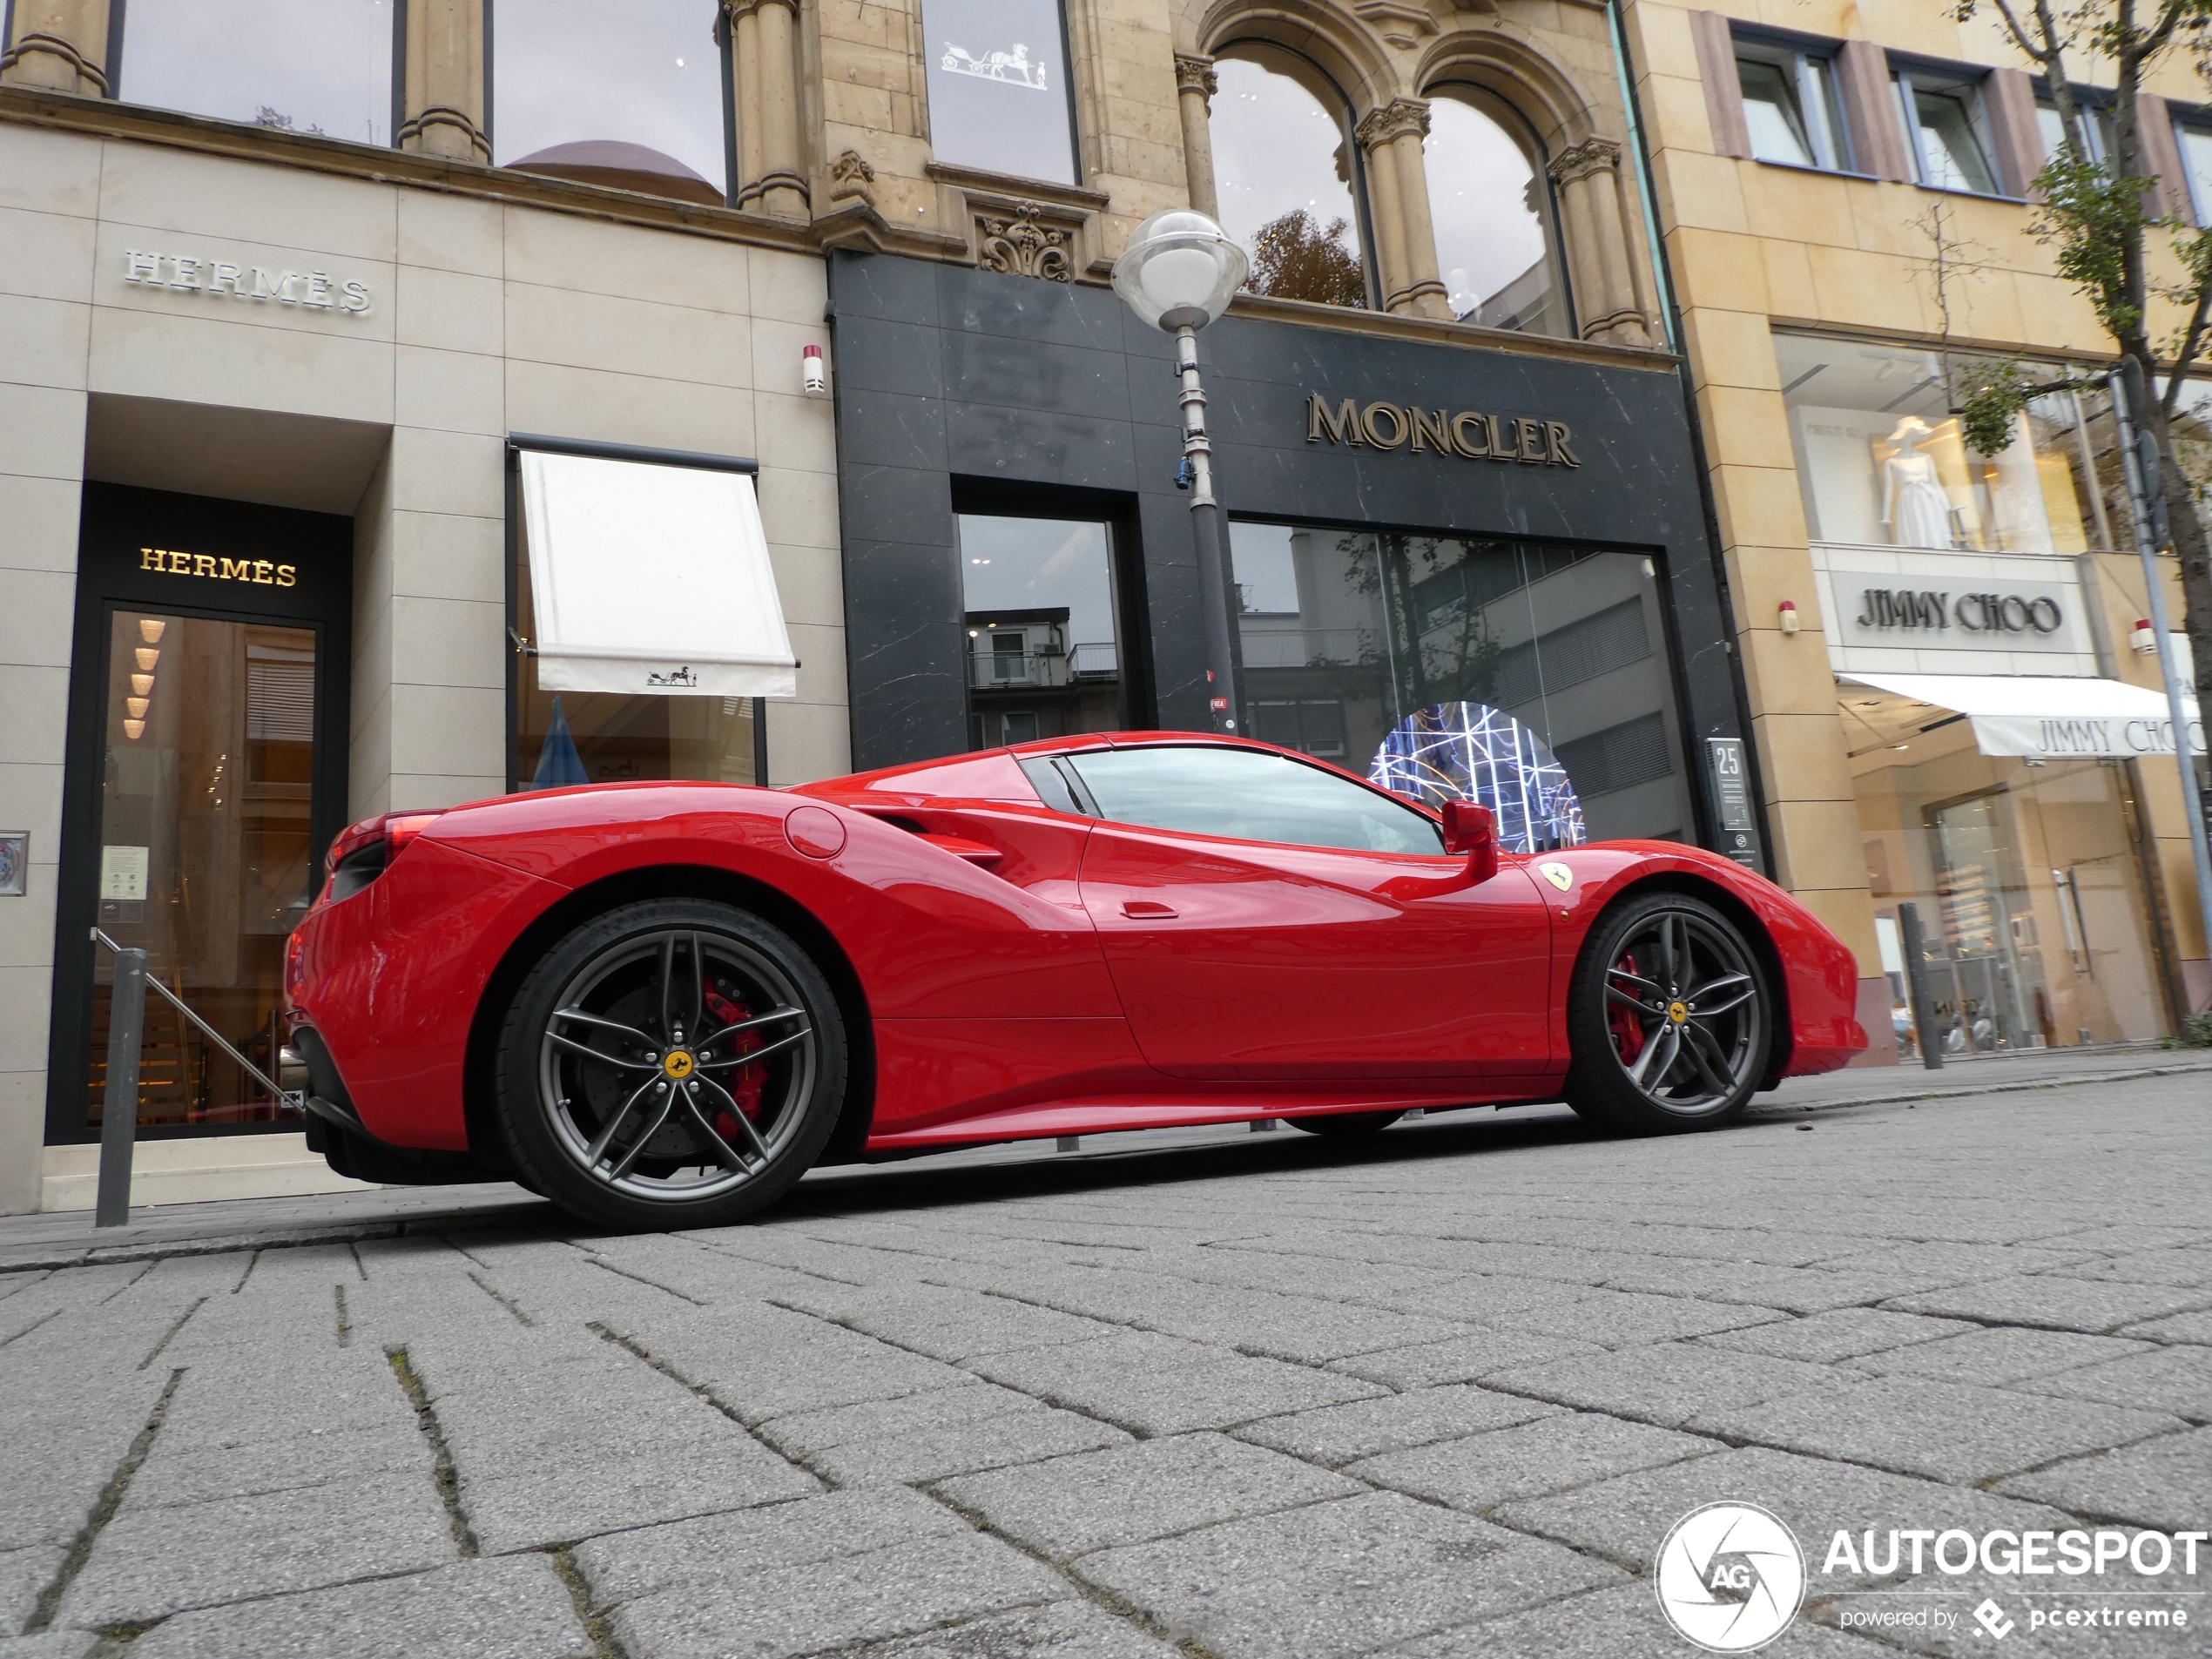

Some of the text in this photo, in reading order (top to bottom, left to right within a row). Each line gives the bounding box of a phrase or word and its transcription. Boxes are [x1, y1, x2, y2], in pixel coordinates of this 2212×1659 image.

[1306, 395, 1582, 468] MONCLER
[1857, 588, 2063, 633] JIMMY CHOO
[2036, 719, 2112, 752] JIMMY
[1716, 746, 1740, 775] 25
